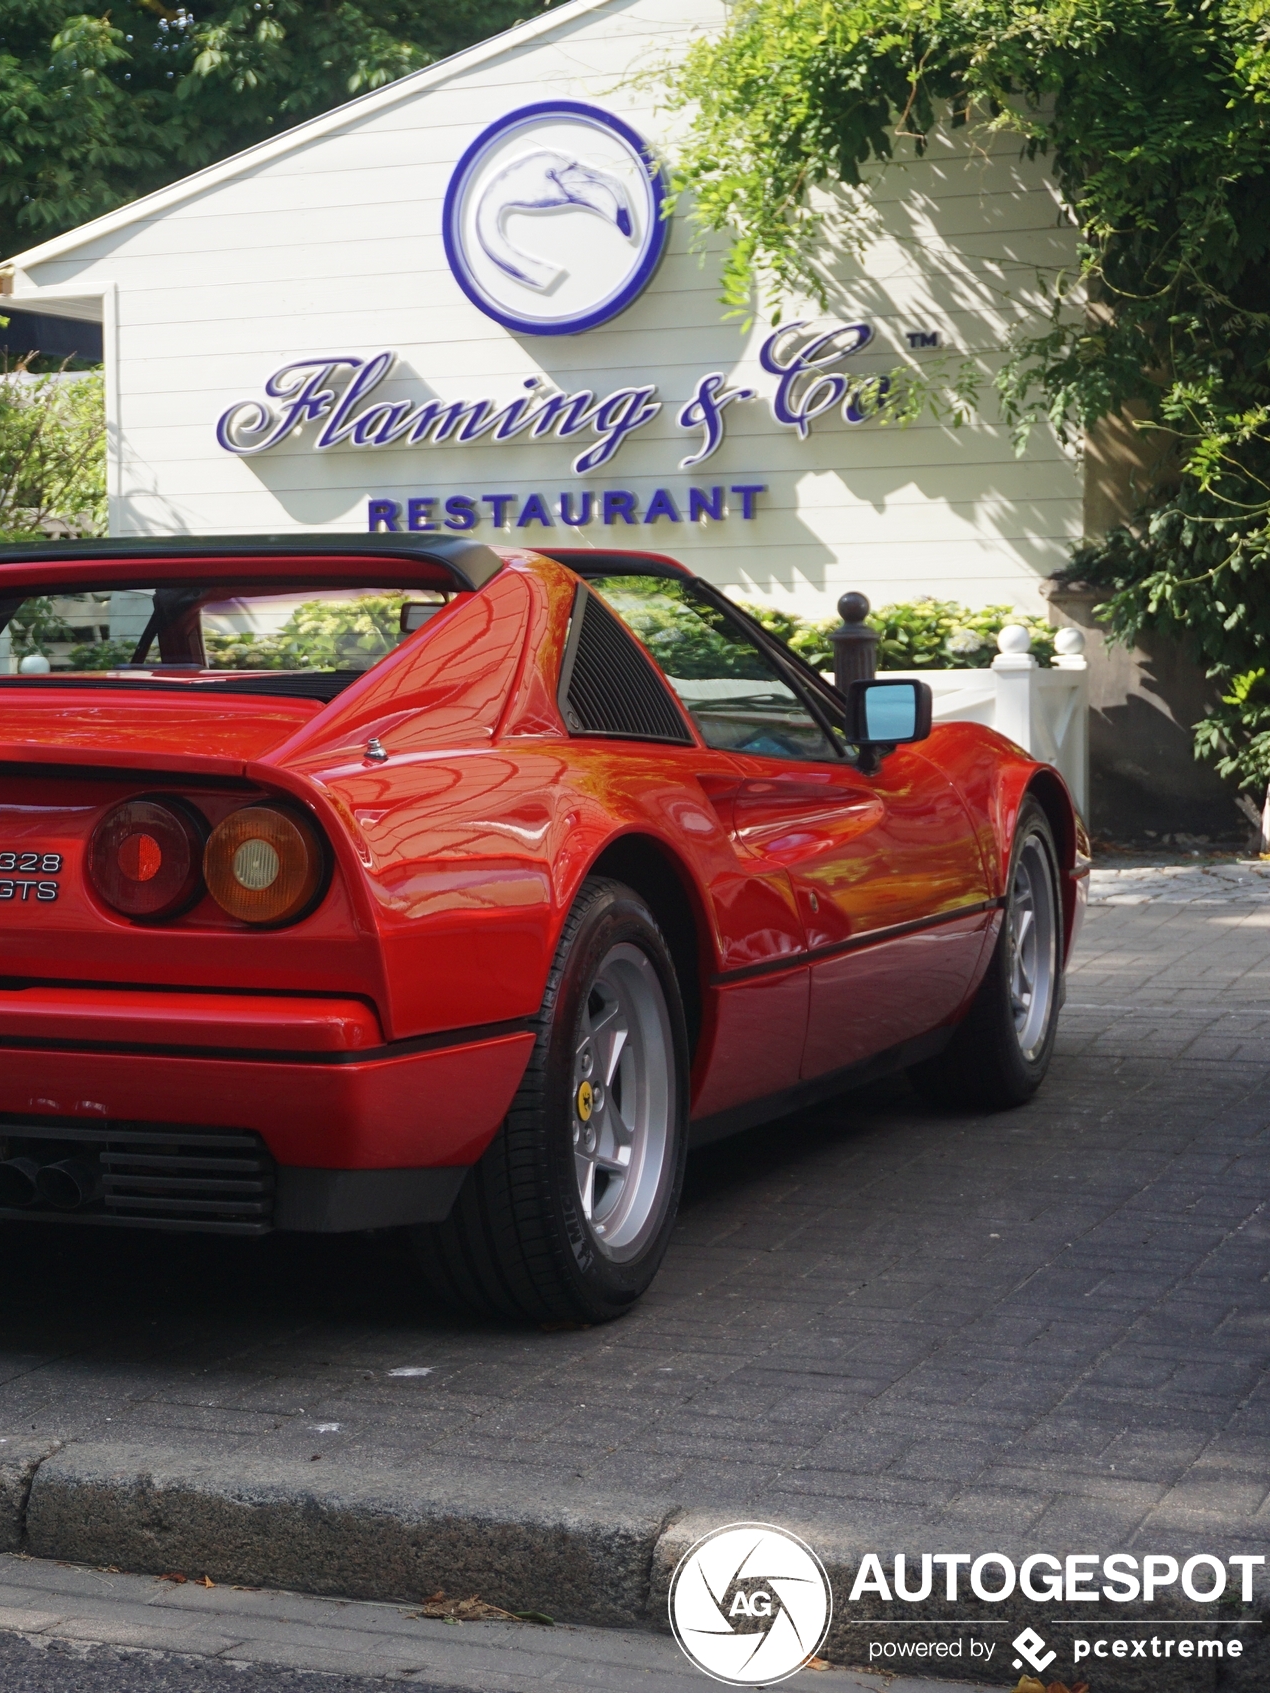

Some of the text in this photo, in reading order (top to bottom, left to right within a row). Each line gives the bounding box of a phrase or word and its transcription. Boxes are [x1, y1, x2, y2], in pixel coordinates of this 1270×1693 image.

[216, 350, 661, 474] Flaming
[678, 372, 756, 470] &
[368, 484, 768, 533] RESTAURANT
